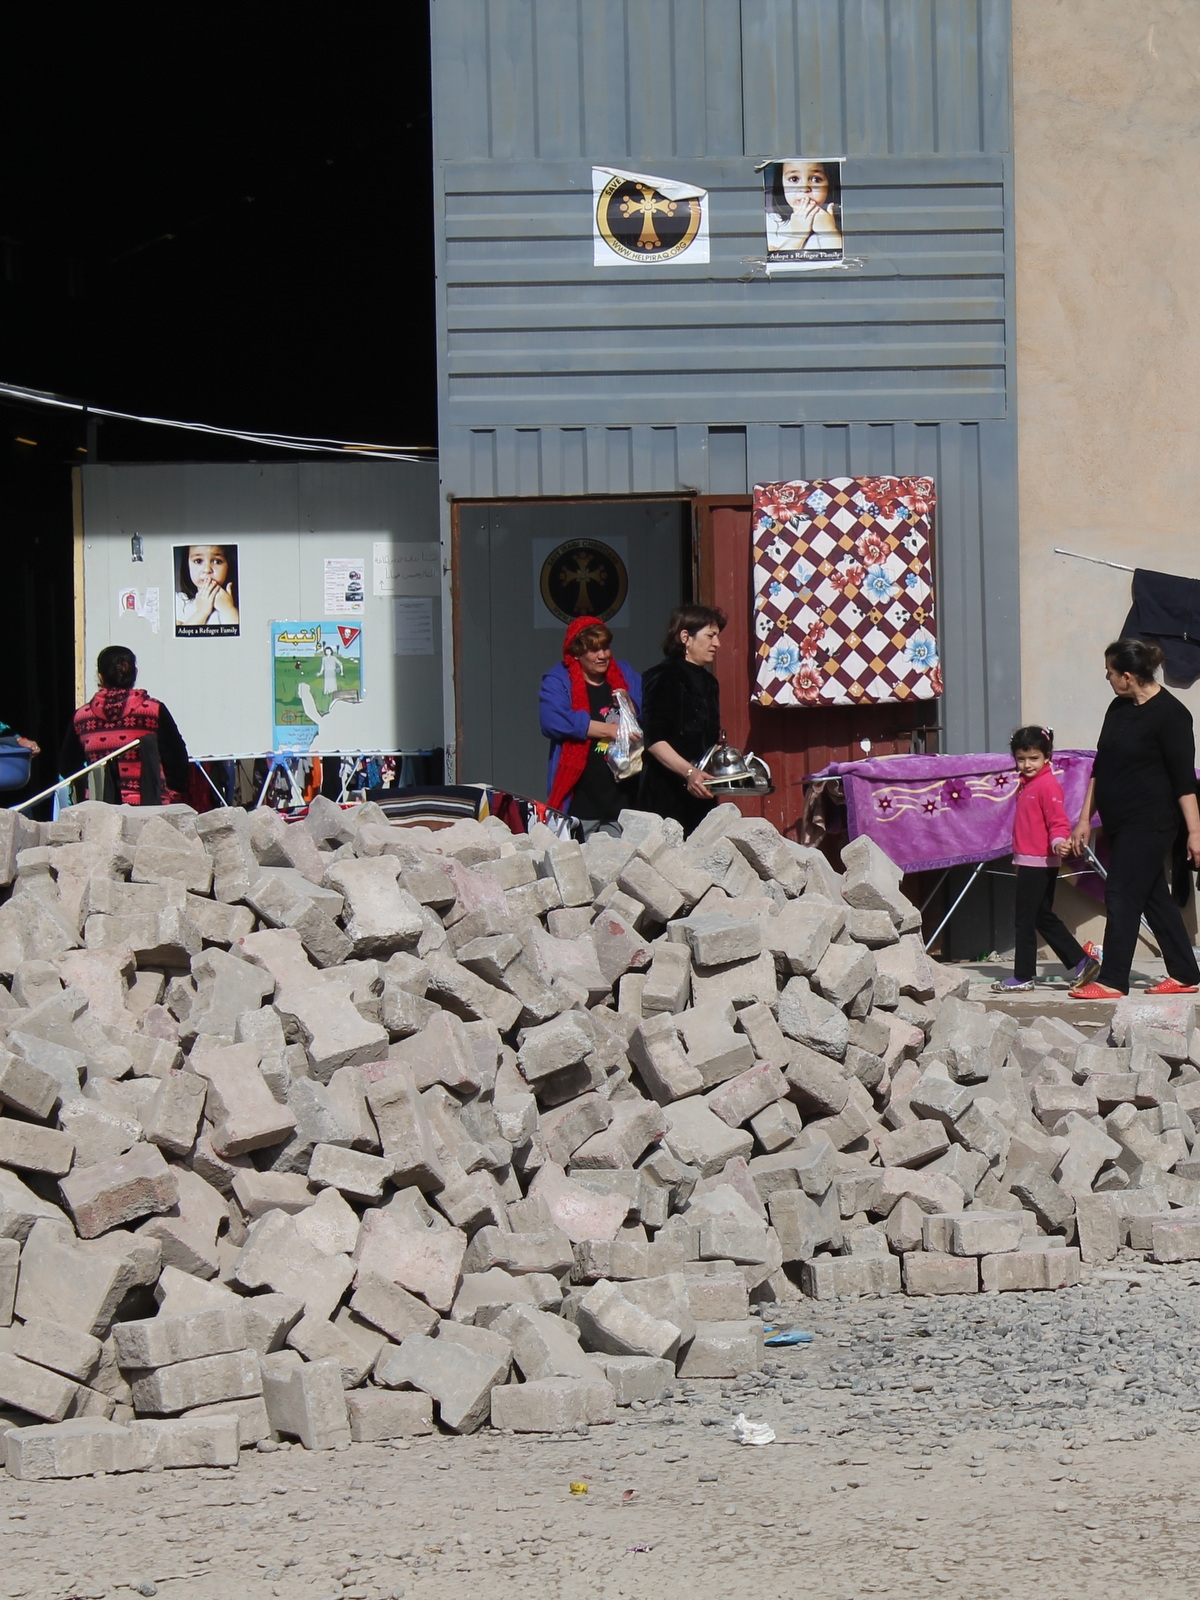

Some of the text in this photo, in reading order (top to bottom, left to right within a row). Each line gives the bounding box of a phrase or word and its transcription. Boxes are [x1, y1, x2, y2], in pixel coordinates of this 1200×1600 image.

[605, 177, 622, 197] SAVE
[612, 240, 687, 261] WWW.HELPIRAQ.ORG
[769, 252, 789, 260] Adopt
[795, 252, 818, 260] Refugee
[820, 251, 841, 259] Family
[178, 627, 194, 636] Adopt
[199, 626, 220, 635] Refugee
[220, 626, 238, 635] Family
